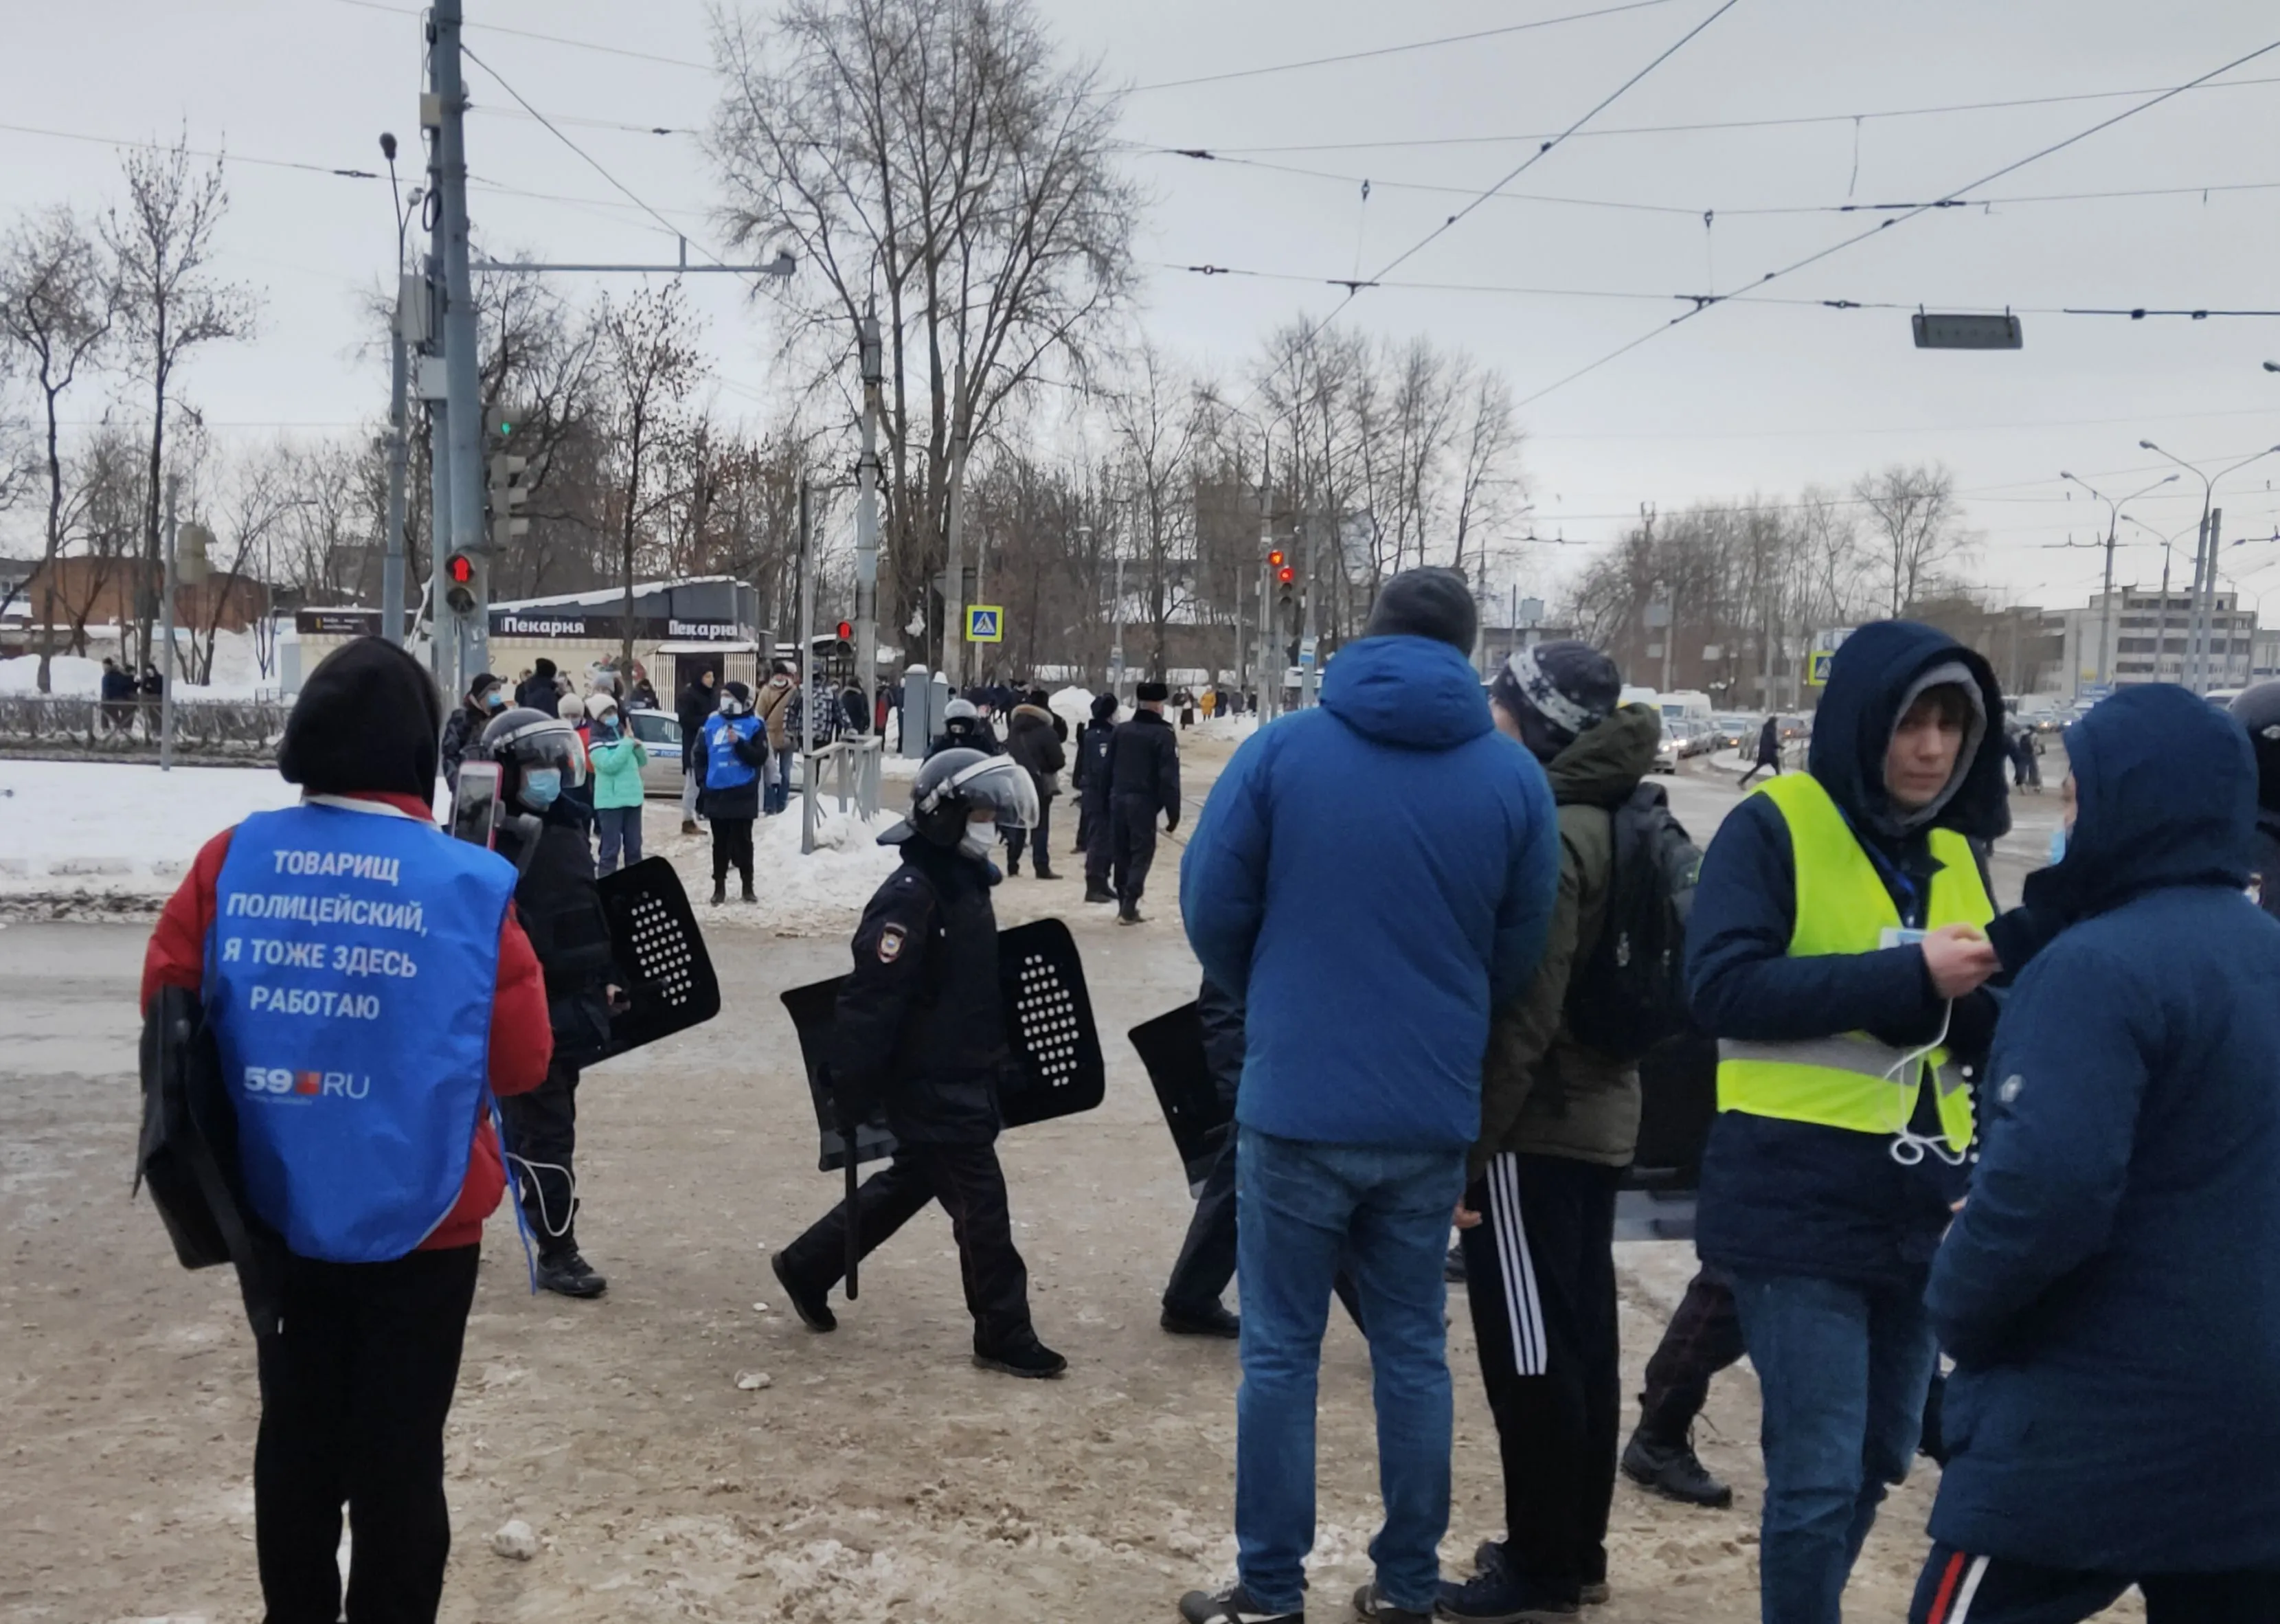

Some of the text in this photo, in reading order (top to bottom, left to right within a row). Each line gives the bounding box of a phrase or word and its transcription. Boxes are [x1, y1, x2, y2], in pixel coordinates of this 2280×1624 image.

[504, 616, 585, 637] Пекарня
[273, 850, 400, 886] ТОВАРИЩ
[225, 892, 428, 938] ПОЛИЦЕЙСКИЙ,
[222, 937, 418, 978] Я ТОЖЕ ЗДЕСЬ
[249, 985, 380, 1020] РАБОТАЮ
